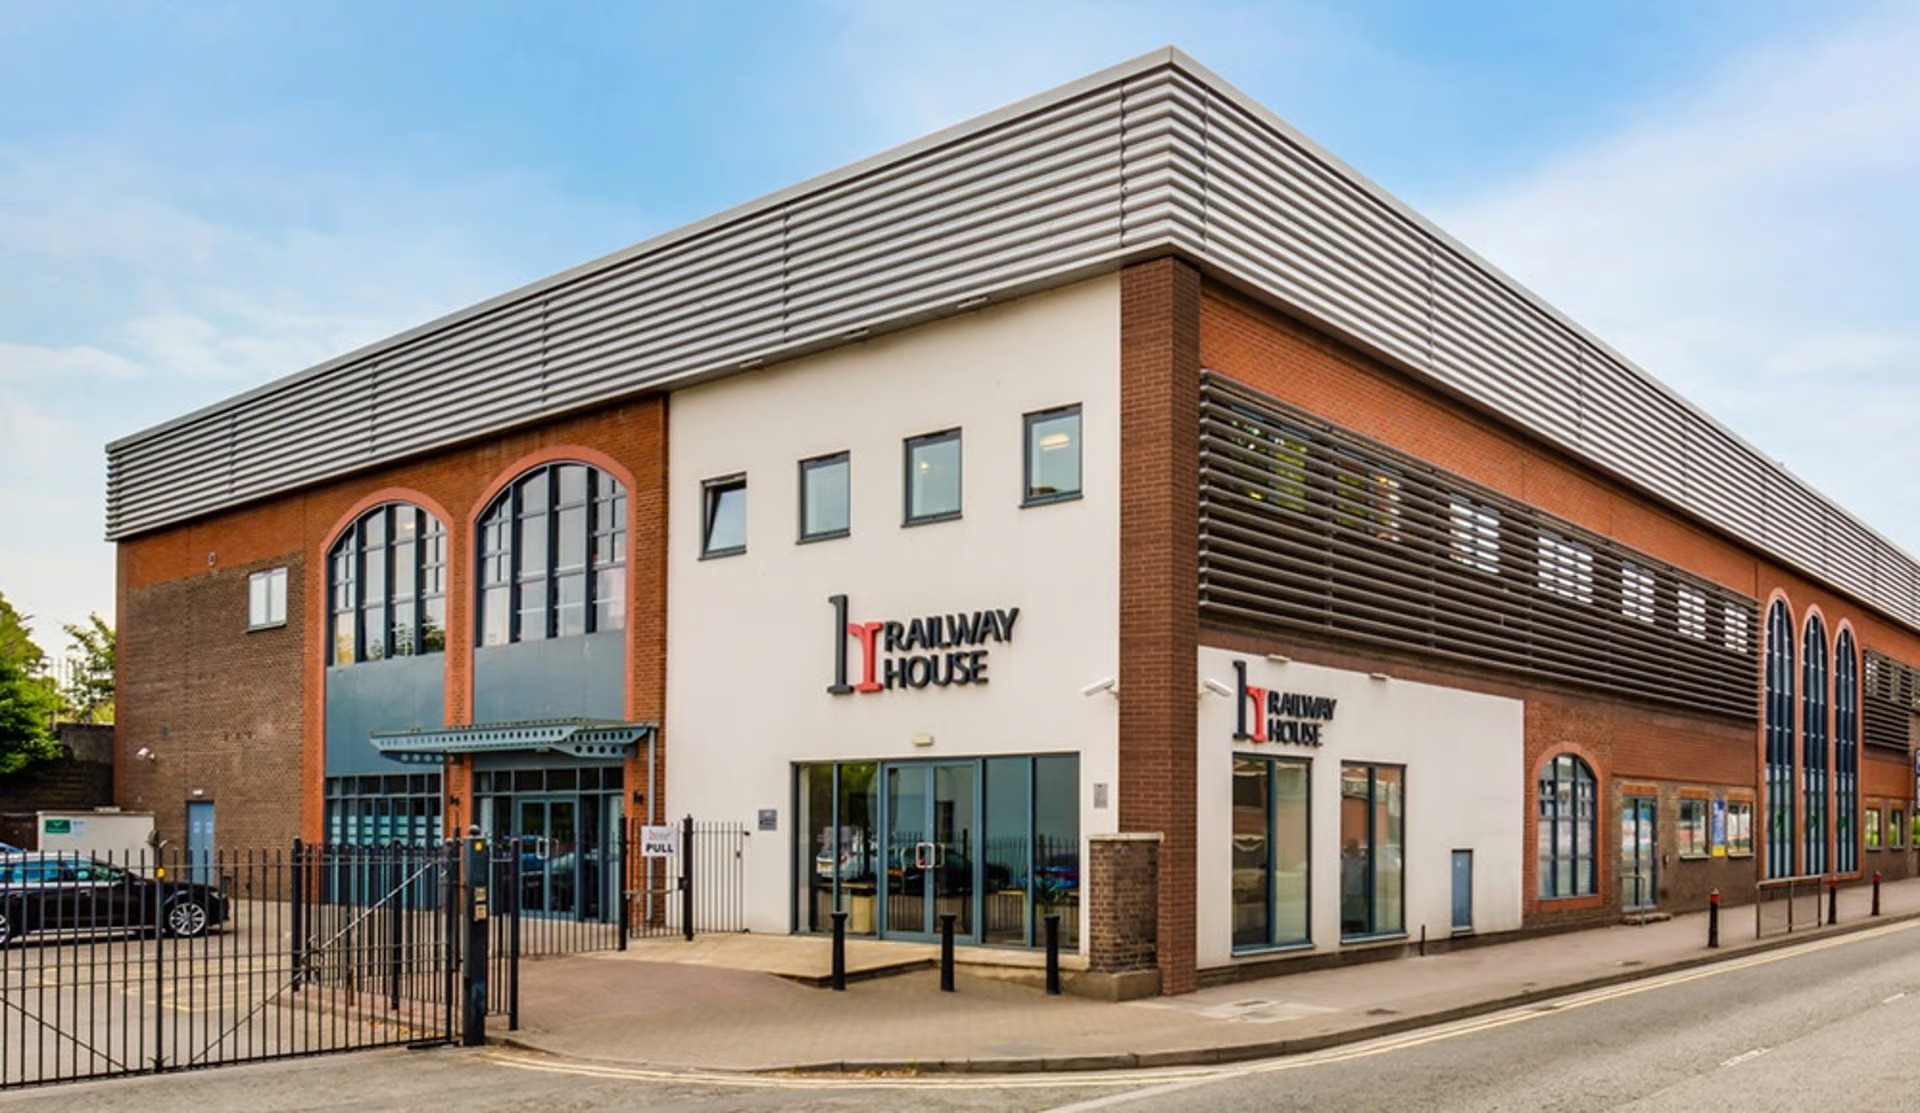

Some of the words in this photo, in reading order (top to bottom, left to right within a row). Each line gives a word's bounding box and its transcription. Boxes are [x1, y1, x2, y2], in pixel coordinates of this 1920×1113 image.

[884, 607, 1020, 653] RAILWAY
[884, 650, 989, 690] HOUSE
[1268, 690, 1337, 721] RAILWAY
[1268, 718, 1324, 748] HOUSE
[645, 843, 674, 853] PULL
